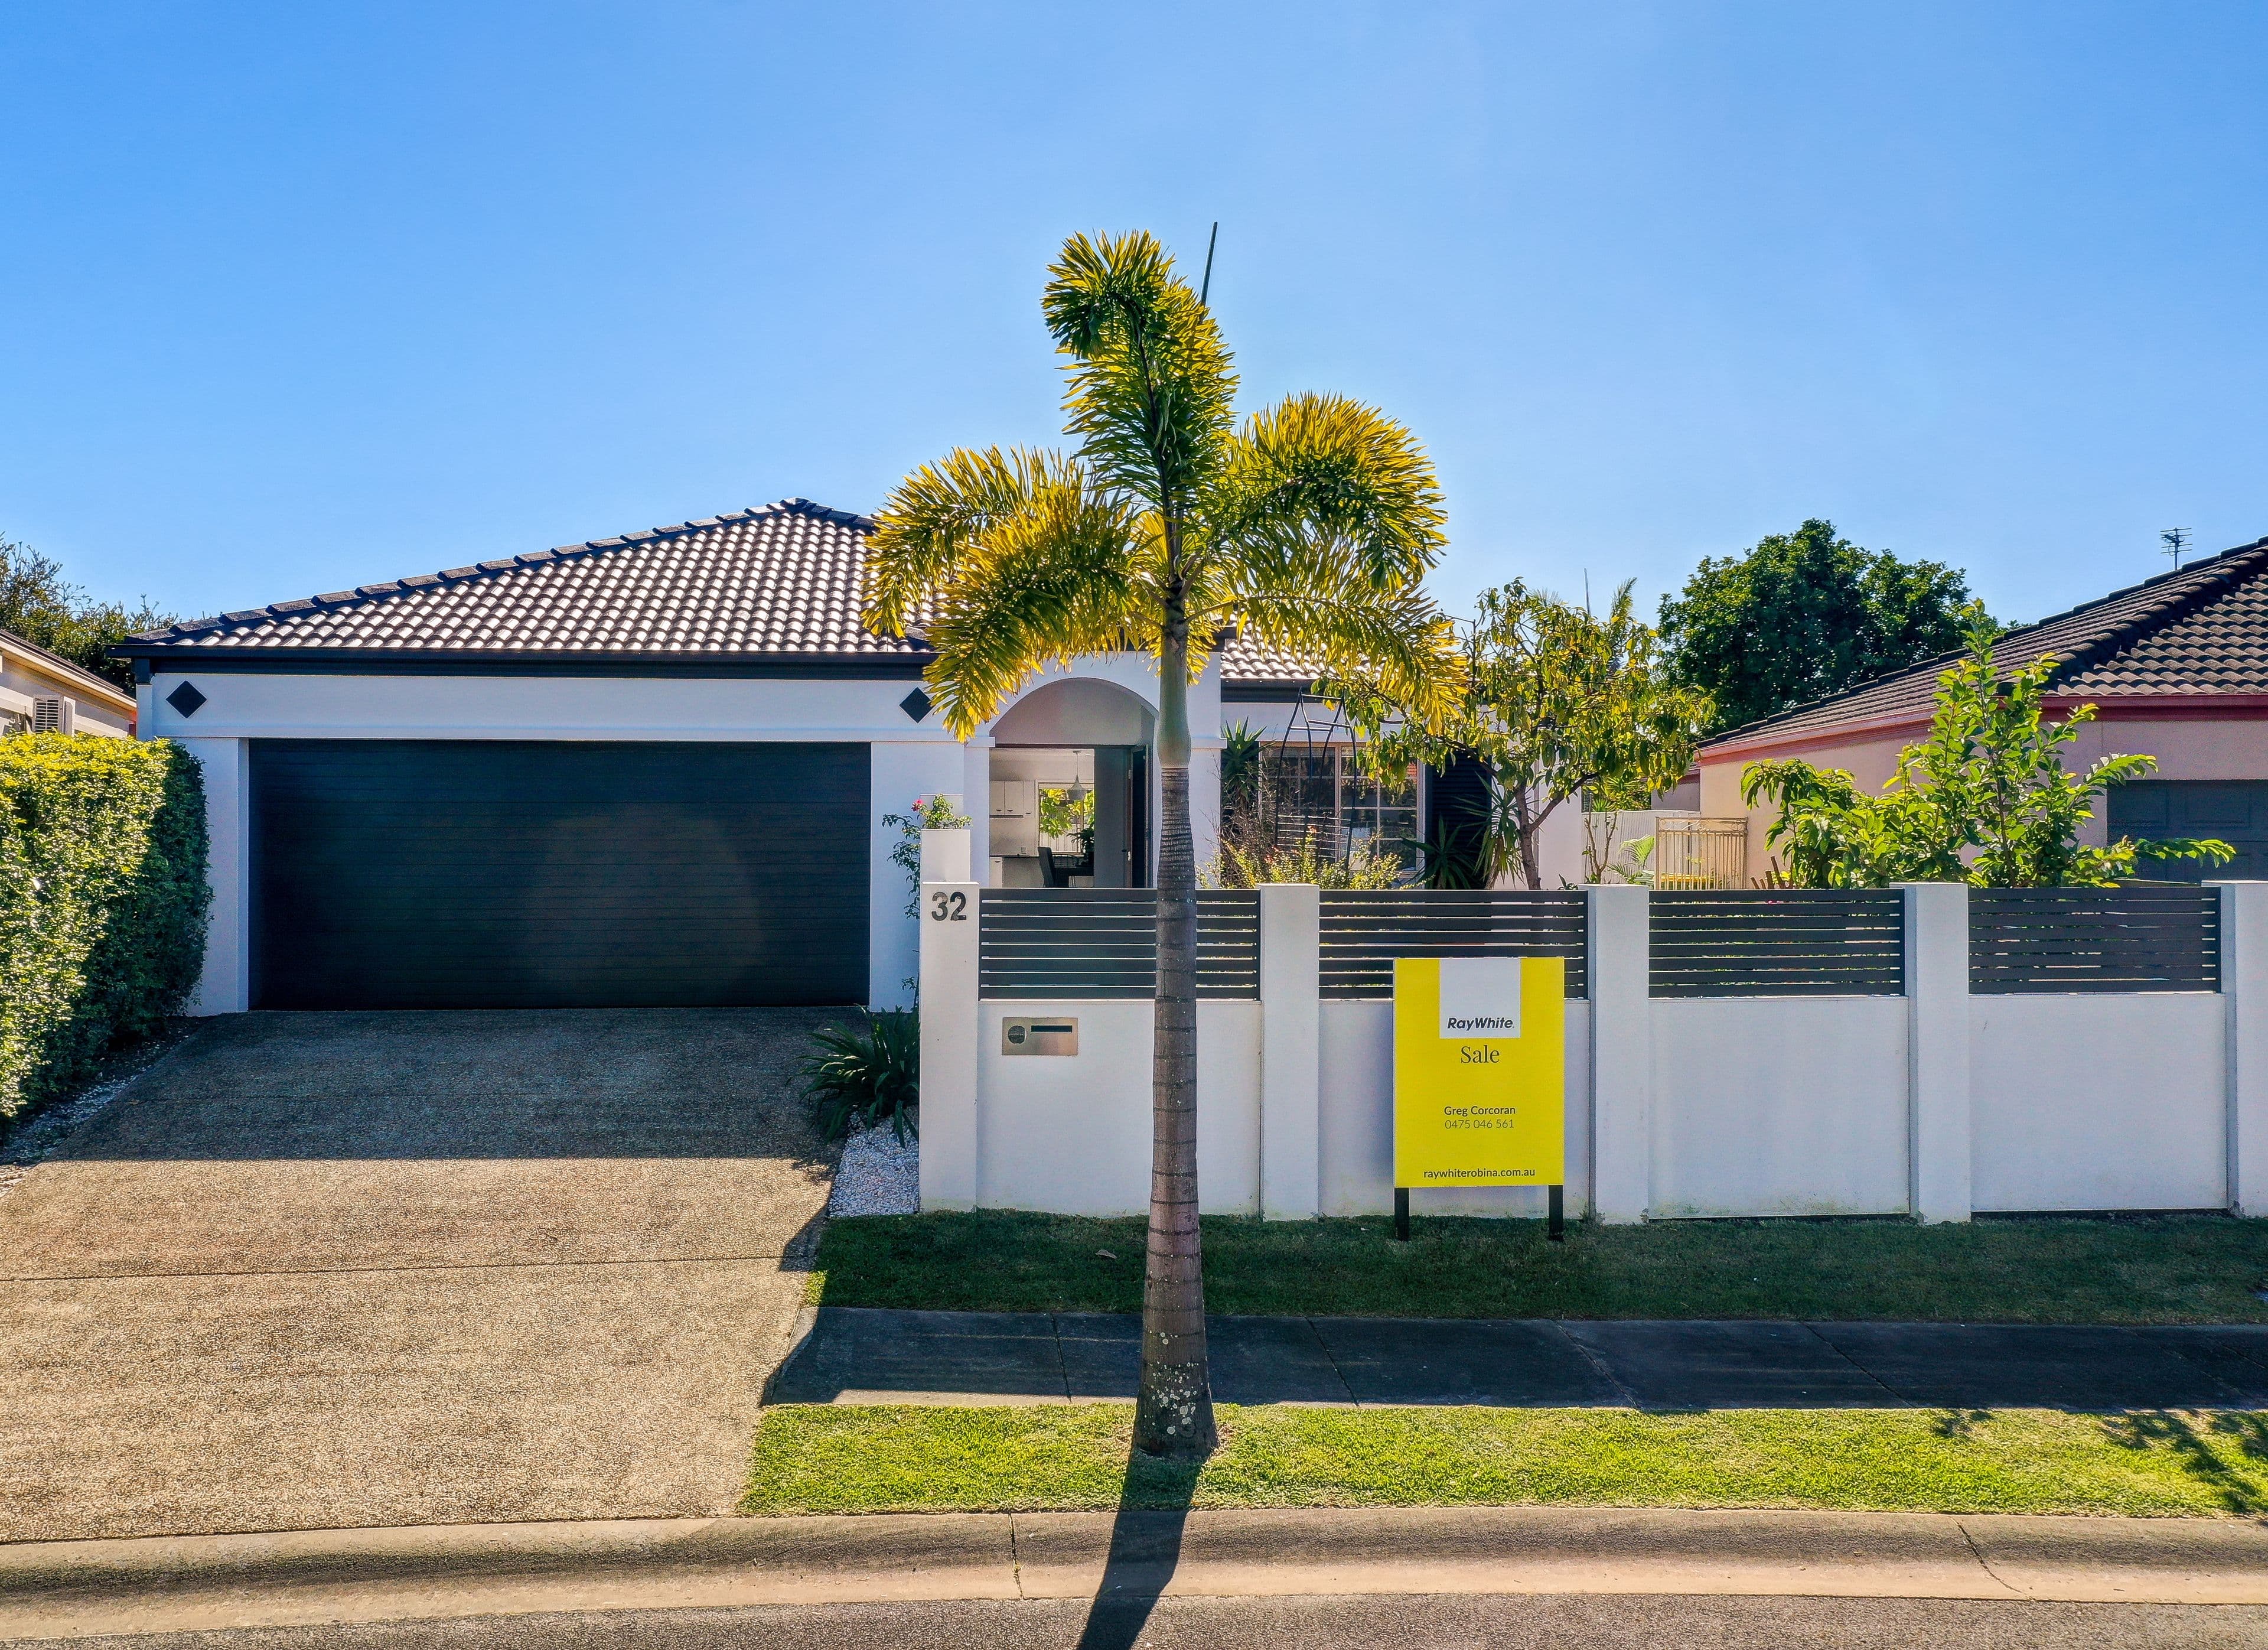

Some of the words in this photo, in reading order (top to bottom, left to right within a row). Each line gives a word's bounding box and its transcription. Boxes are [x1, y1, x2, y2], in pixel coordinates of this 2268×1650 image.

[931, 891, 967, 921] 32
[1461, 1044, 1500, 1063] Sale
[1444, 1106, 1468, 1117] Greg
[1471, 1106, 1516, 1115] Corcoran
[1445, 1119, 1470, 1129] 0475
[1473, 1119, 1493, 1128] 046
[1496, 1119, 1514, 1128] 561
[1423, 1168, 1536, 1179] raywhiterobina.com.au
